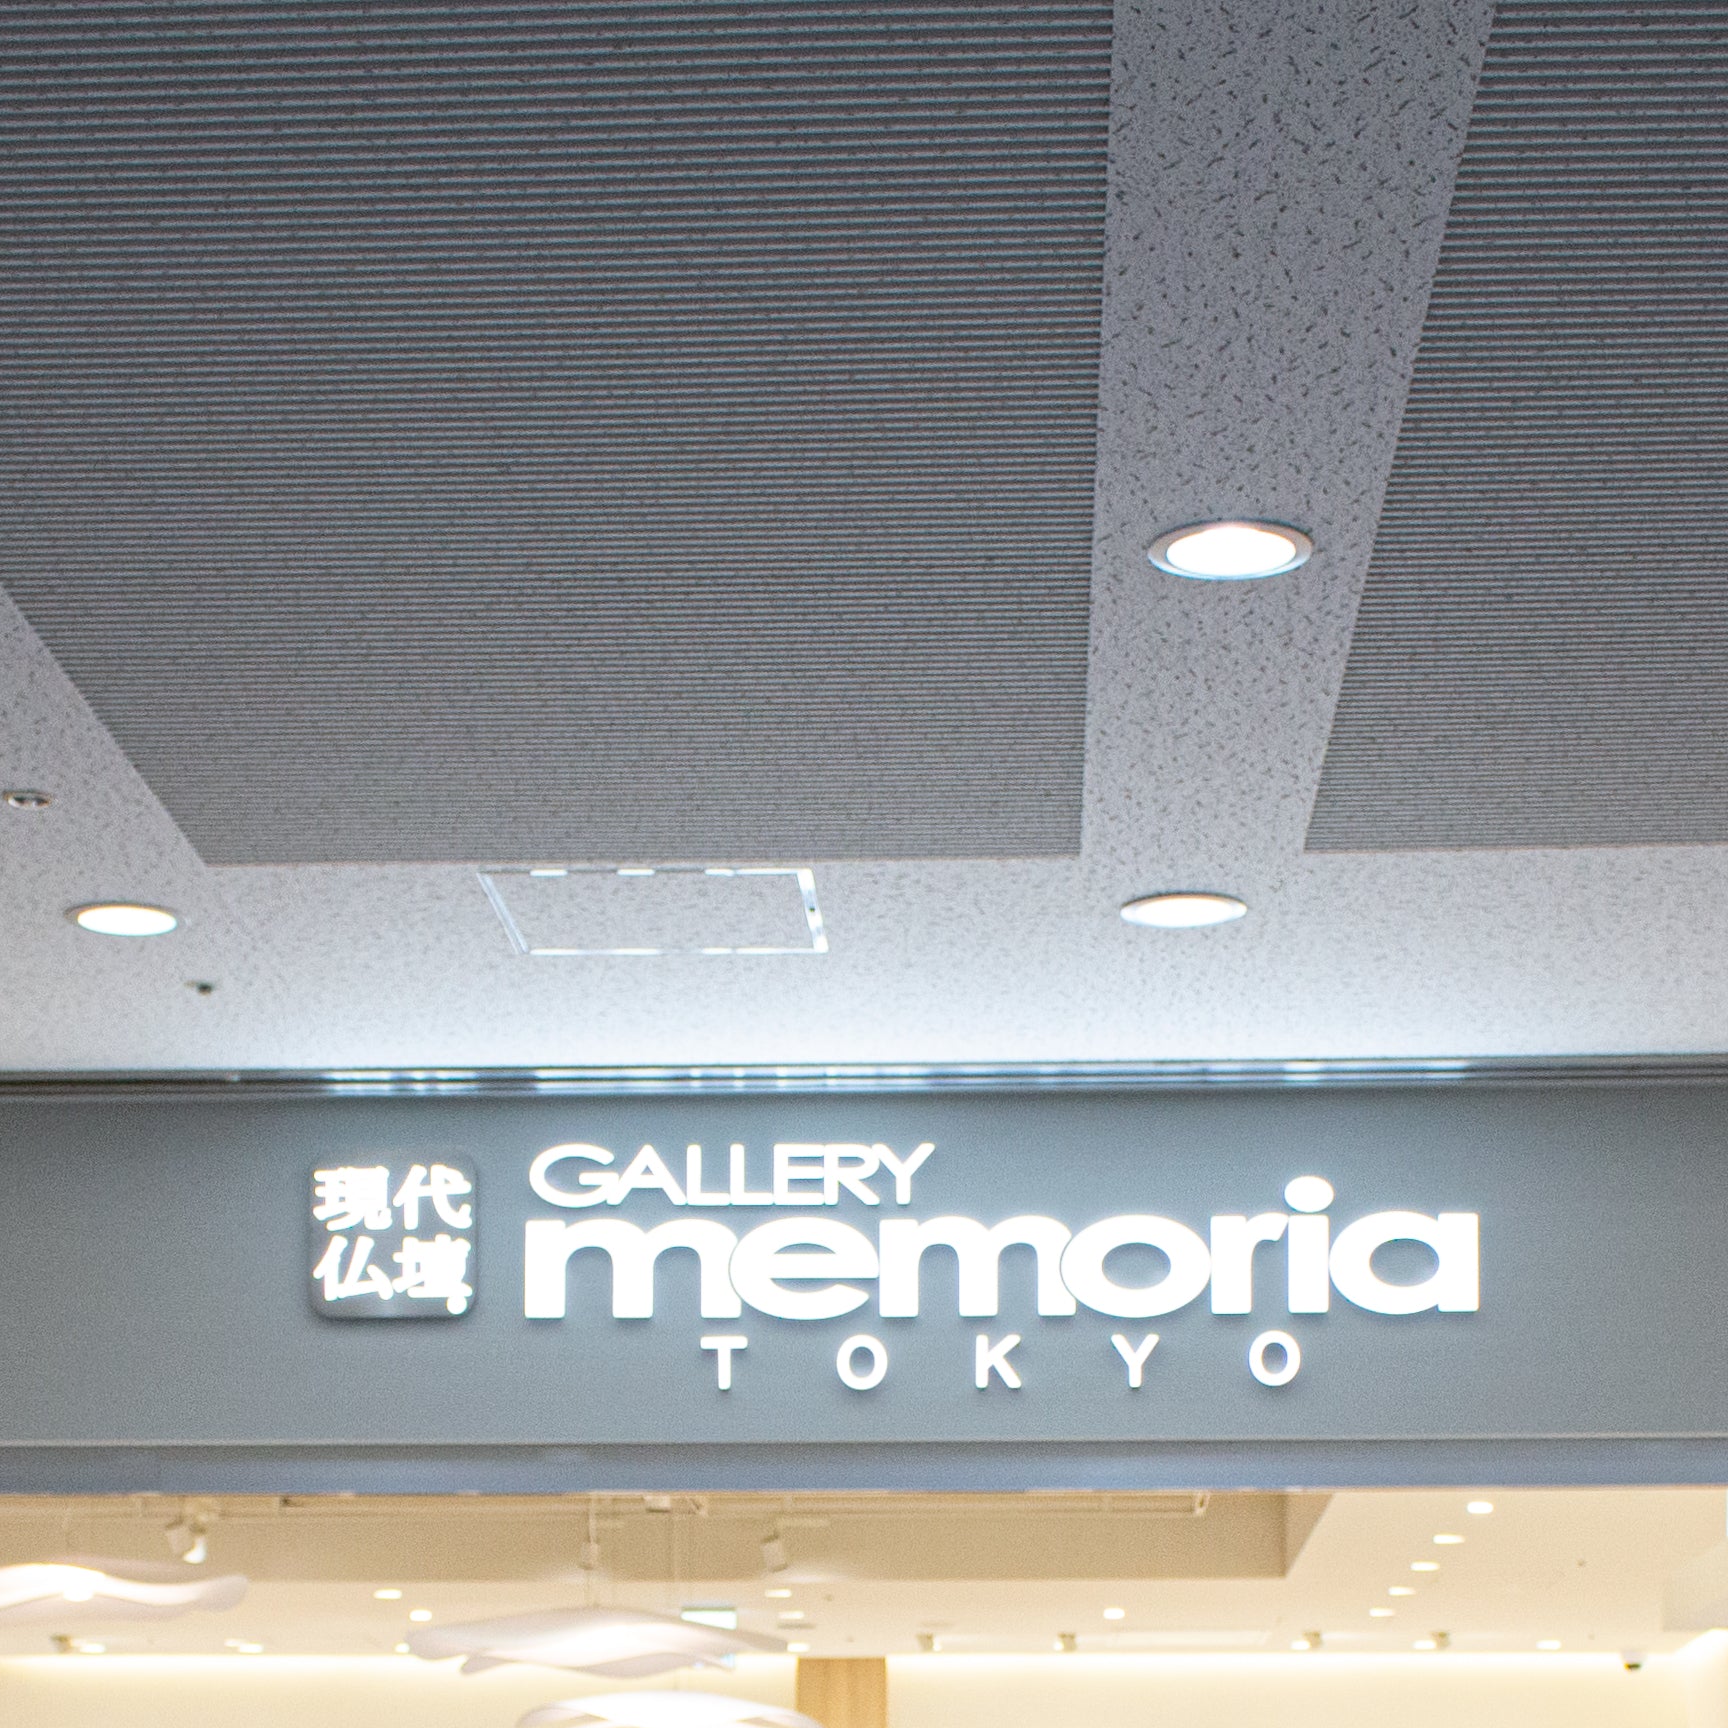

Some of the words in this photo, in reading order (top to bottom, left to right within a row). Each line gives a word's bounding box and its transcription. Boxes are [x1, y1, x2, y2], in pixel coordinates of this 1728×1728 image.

[312, 1163, 473, 1231] 現代
[528, 1142, 936, 1208] GALLERY
[312, 1233, 473, 1300] 仏壇
[524, 1175, 1480, 1320] memoria
[699, 1330, 1302, 1390] TOKYO
